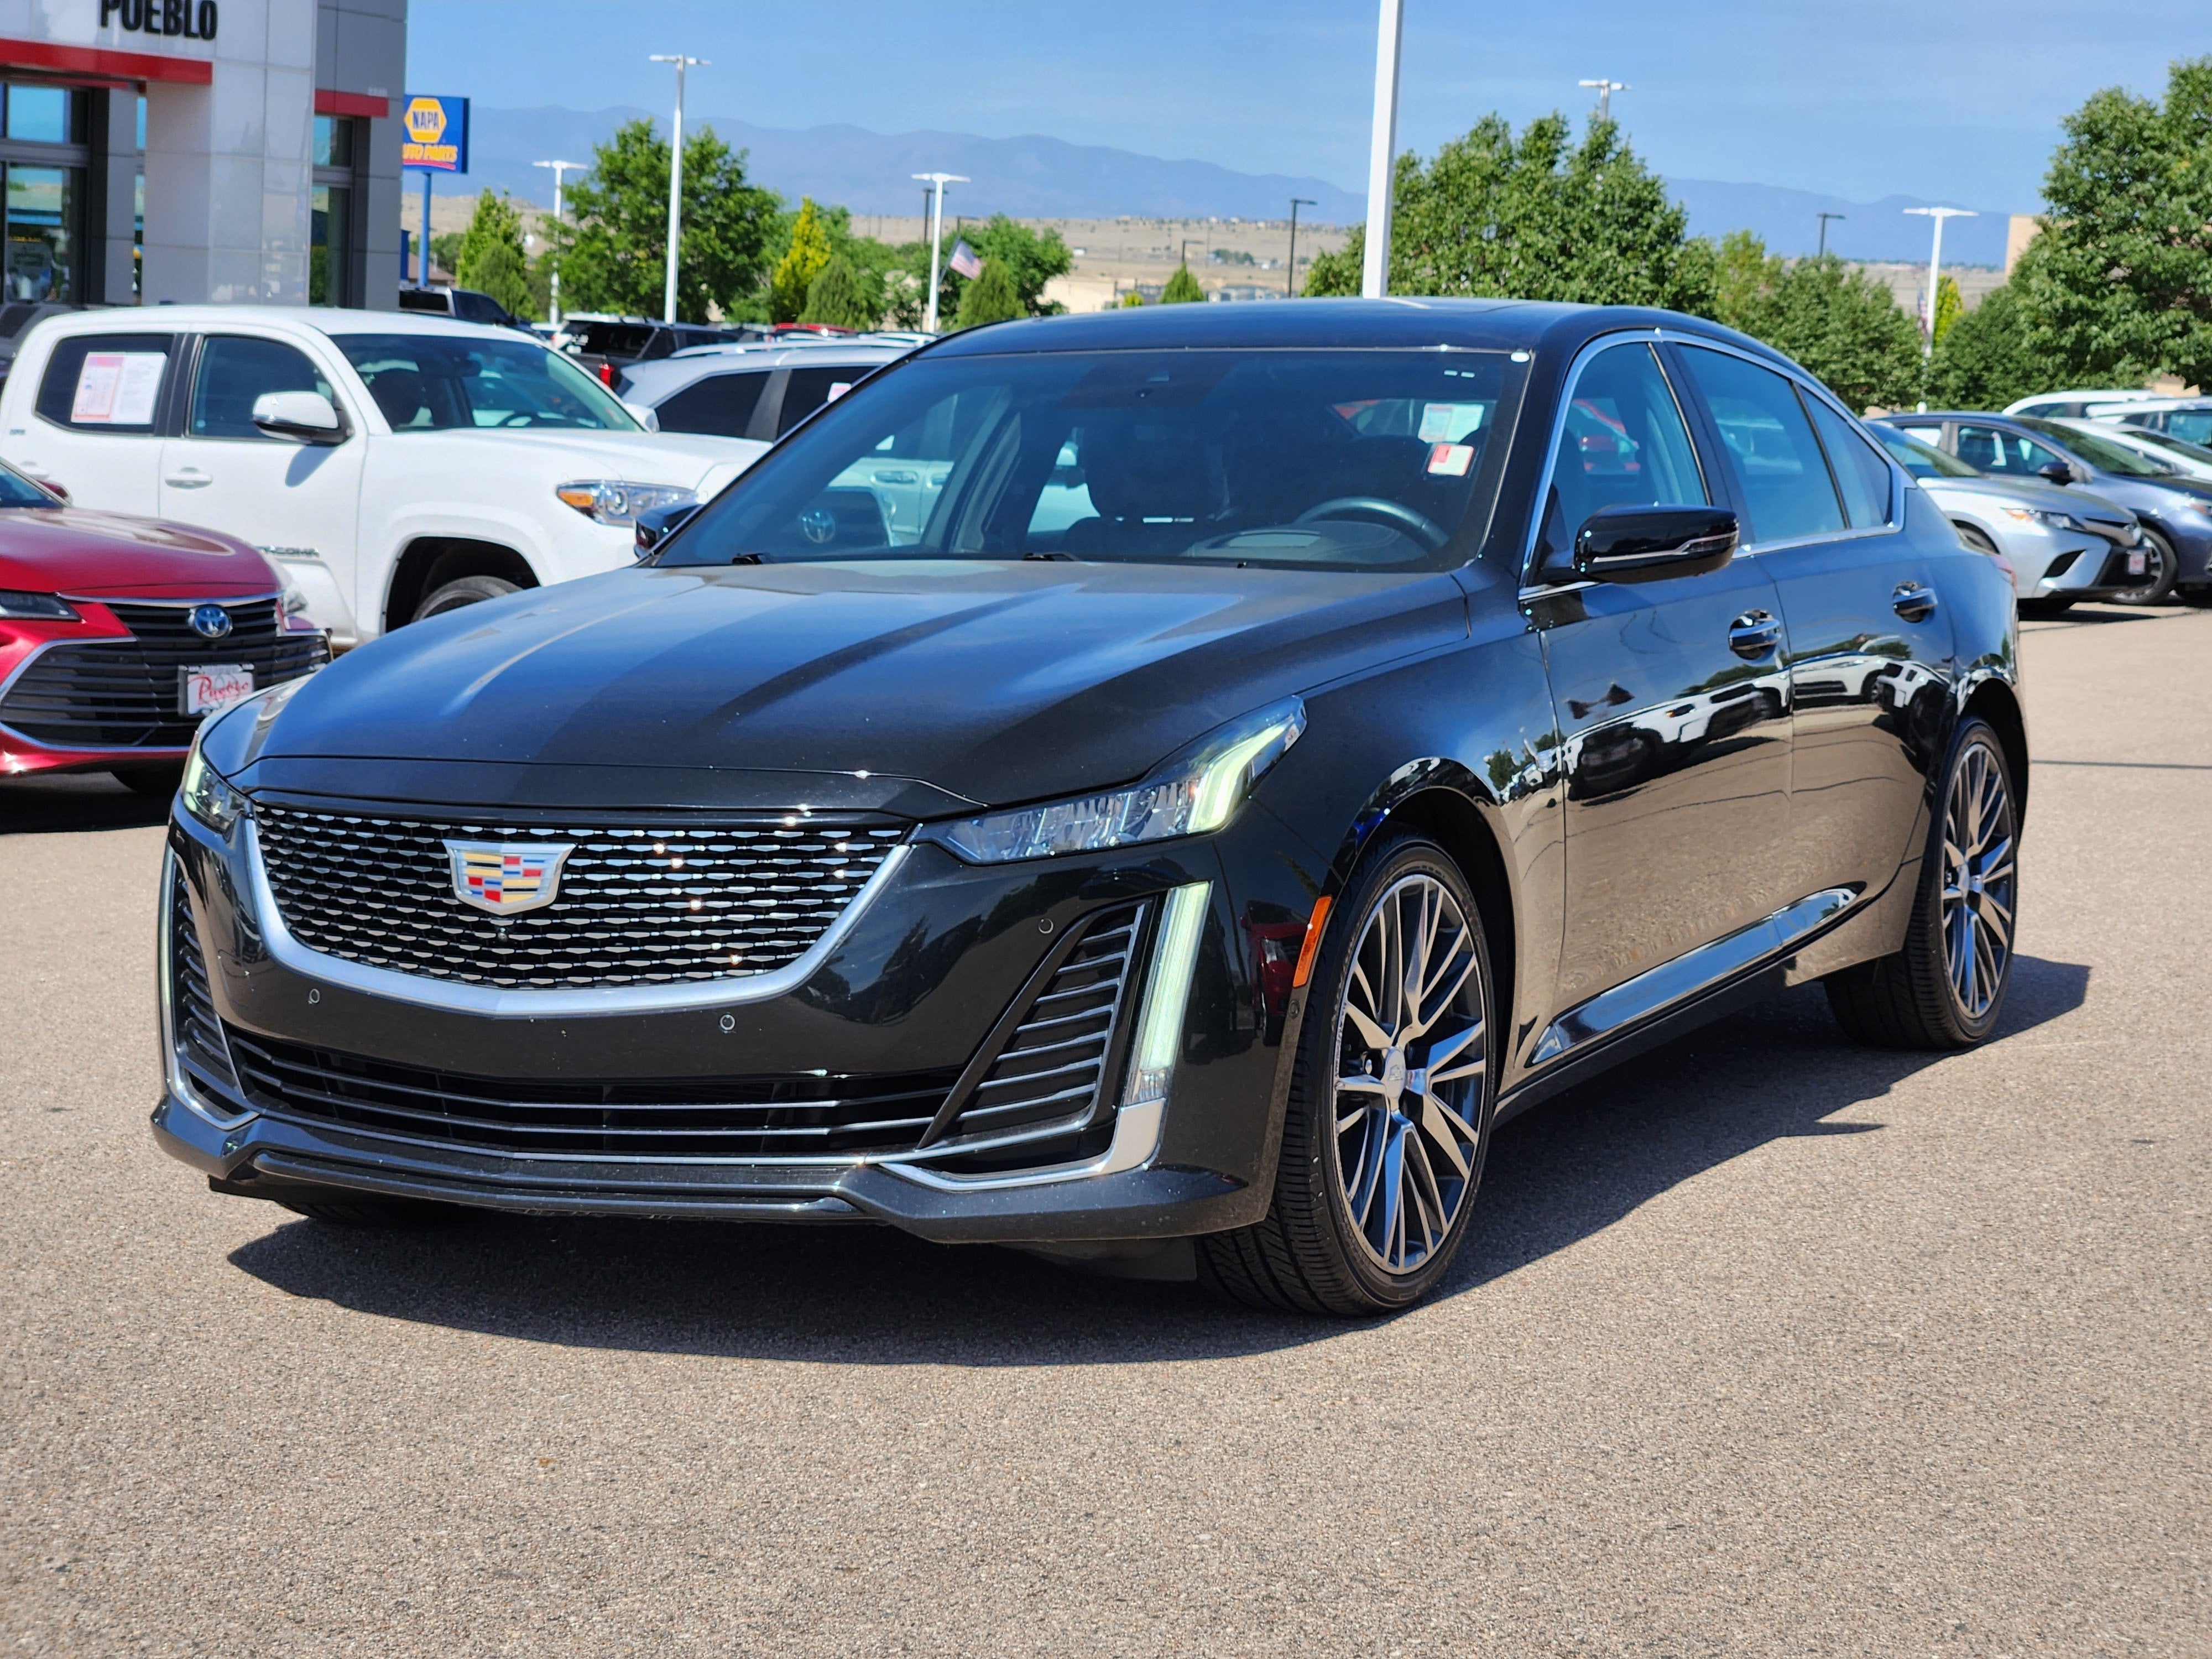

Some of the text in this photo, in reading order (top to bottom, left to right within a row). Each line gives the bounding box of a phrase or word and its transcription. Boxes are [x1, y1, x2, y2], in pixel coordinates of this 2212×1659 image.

[101, 0, 217, 40] PUEBLO
[413, 111, 440, 129] NAPA
[403, 143, 458, 163] UTO PARTS
